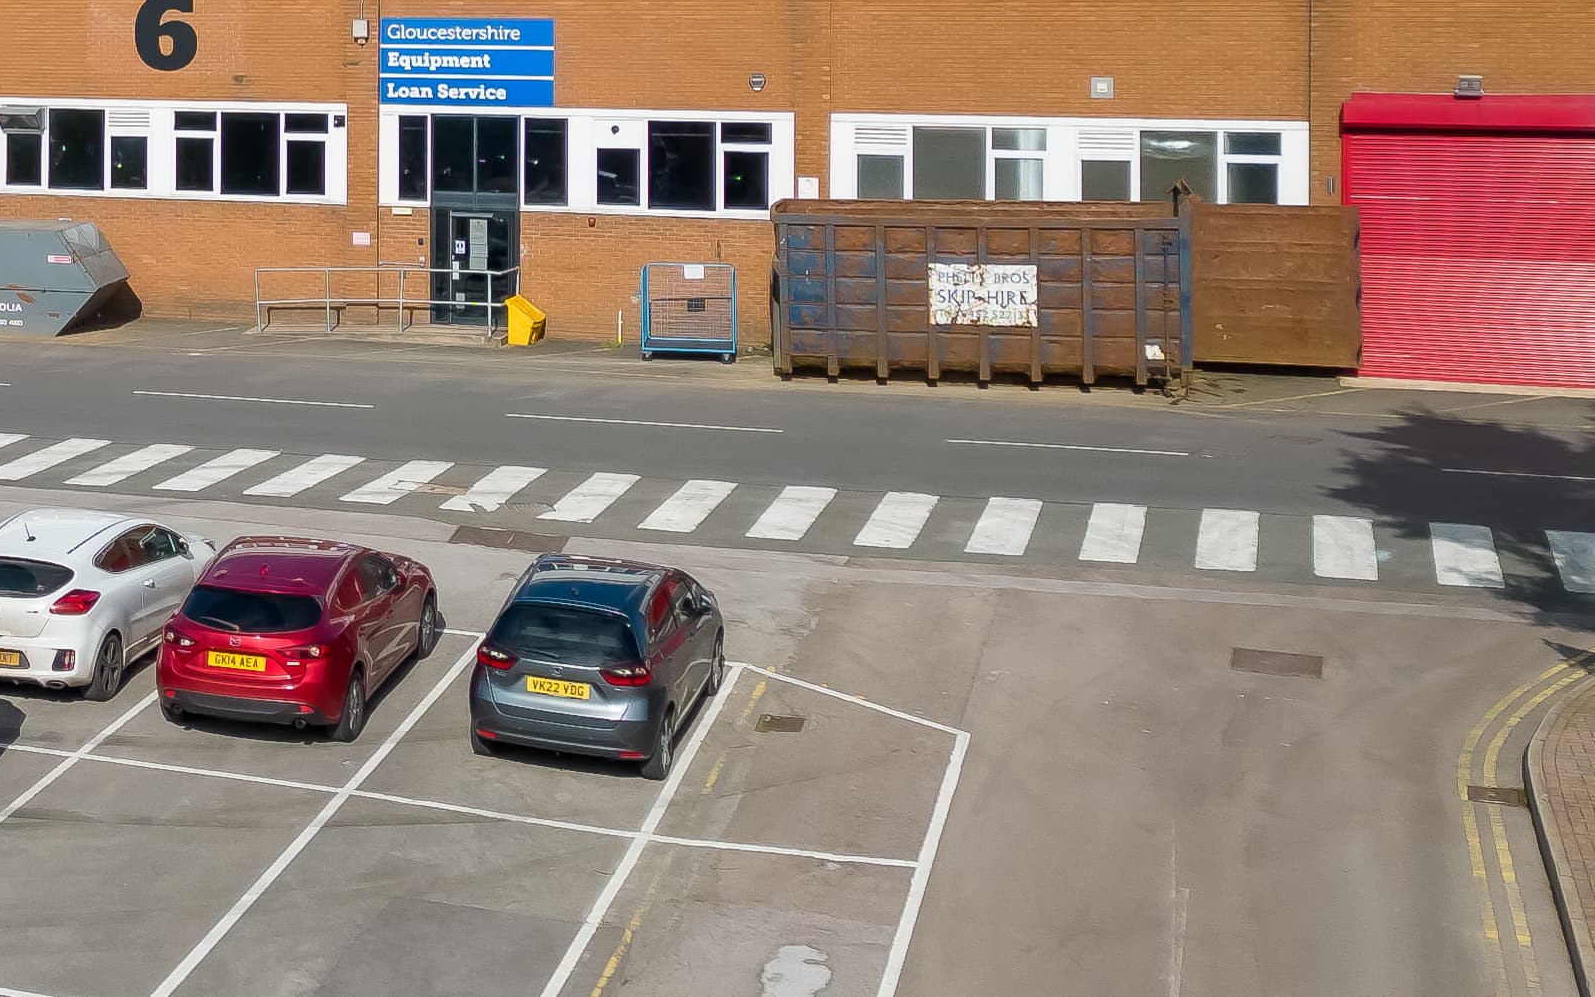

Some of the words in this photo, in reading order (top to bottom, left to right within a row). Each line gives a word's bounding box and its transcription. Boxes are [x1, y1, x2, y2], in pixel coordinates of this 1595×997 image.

[386, 24, 521, 41] Gloucestershire
[387, 51, 491, 70] Equipment
[386, 82, 434, 99] Loan
[437, 83, 507, 100] Service
[937, 289, 975, 304] SKIP
[987, 290, 1027, 305] HIRE
[215, 653, 236, 666] GK14
[239, 656, 258, 668] AEA
[532, 680, 560, 693] VK22
